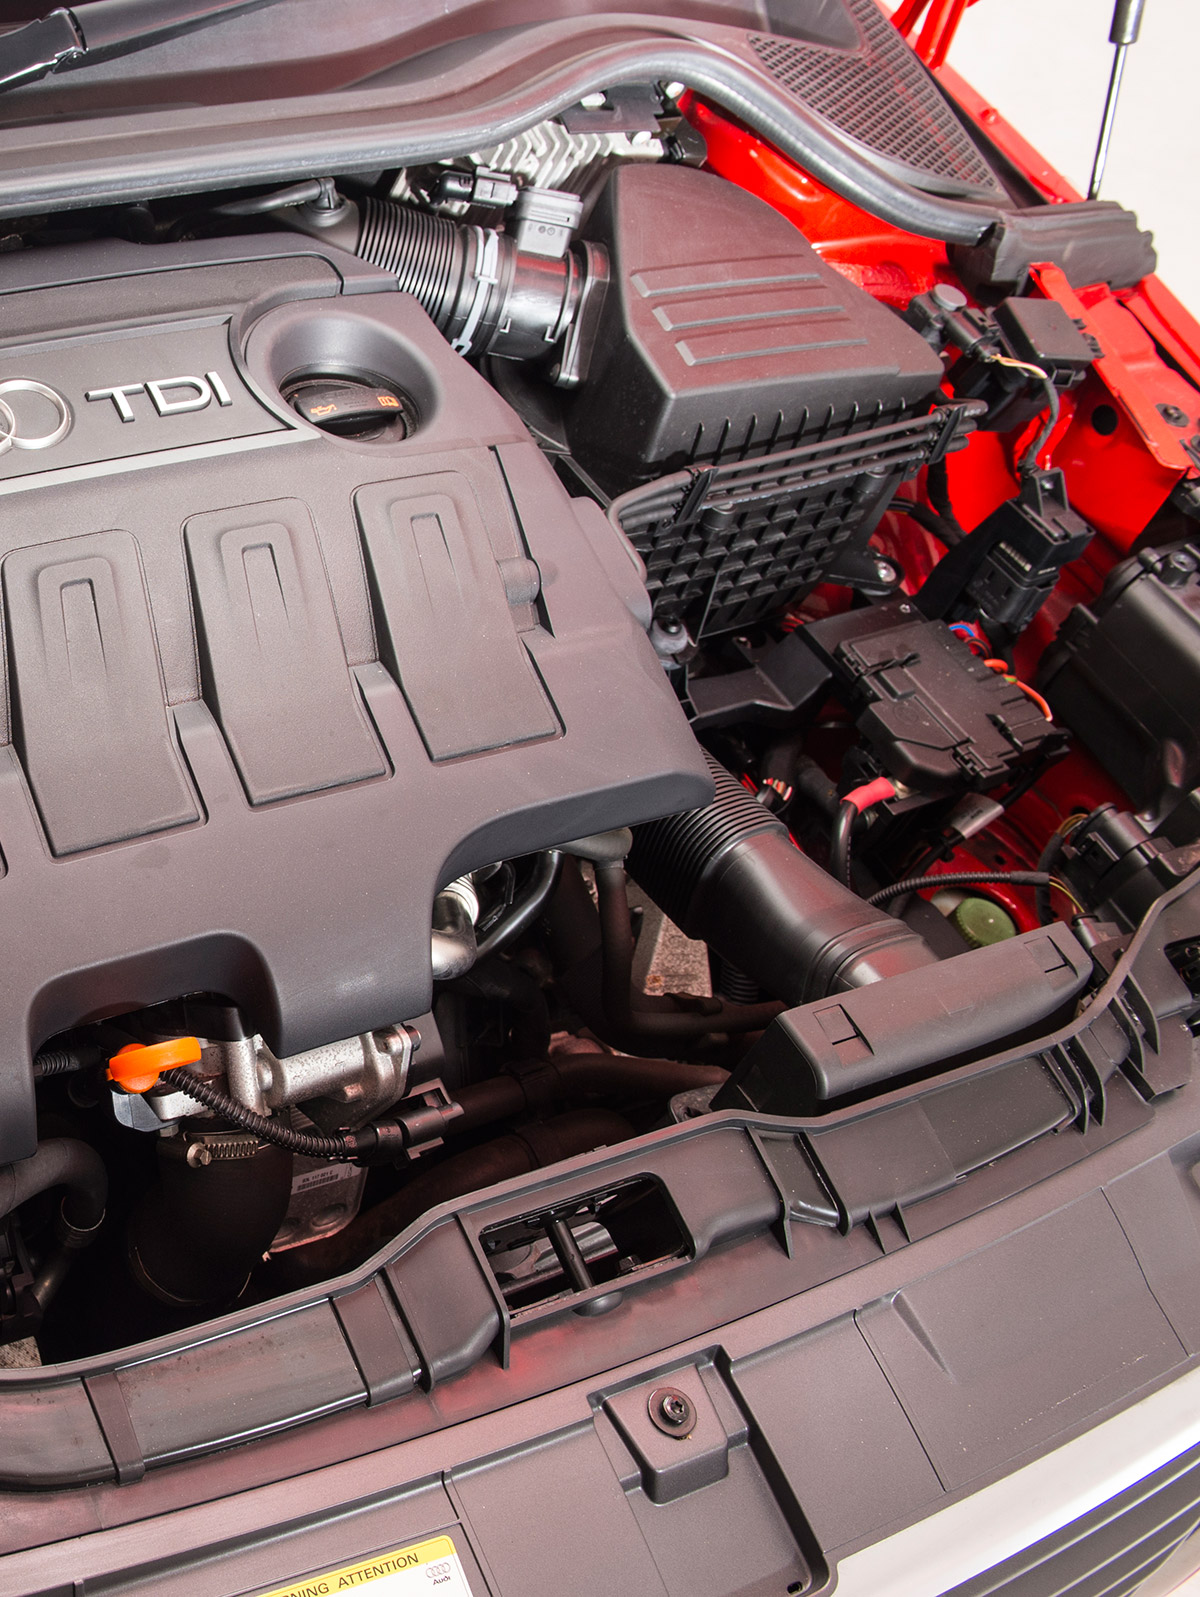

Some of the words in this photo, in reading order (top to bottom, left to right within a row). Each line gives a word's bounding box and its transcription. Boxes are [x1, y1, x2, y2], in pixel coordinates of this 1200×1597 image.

[83, 370, 233, 424] TDI
[338, 1552, 419, 1588] ATTENTION
[432, 1576, 451, 1586] Audi
